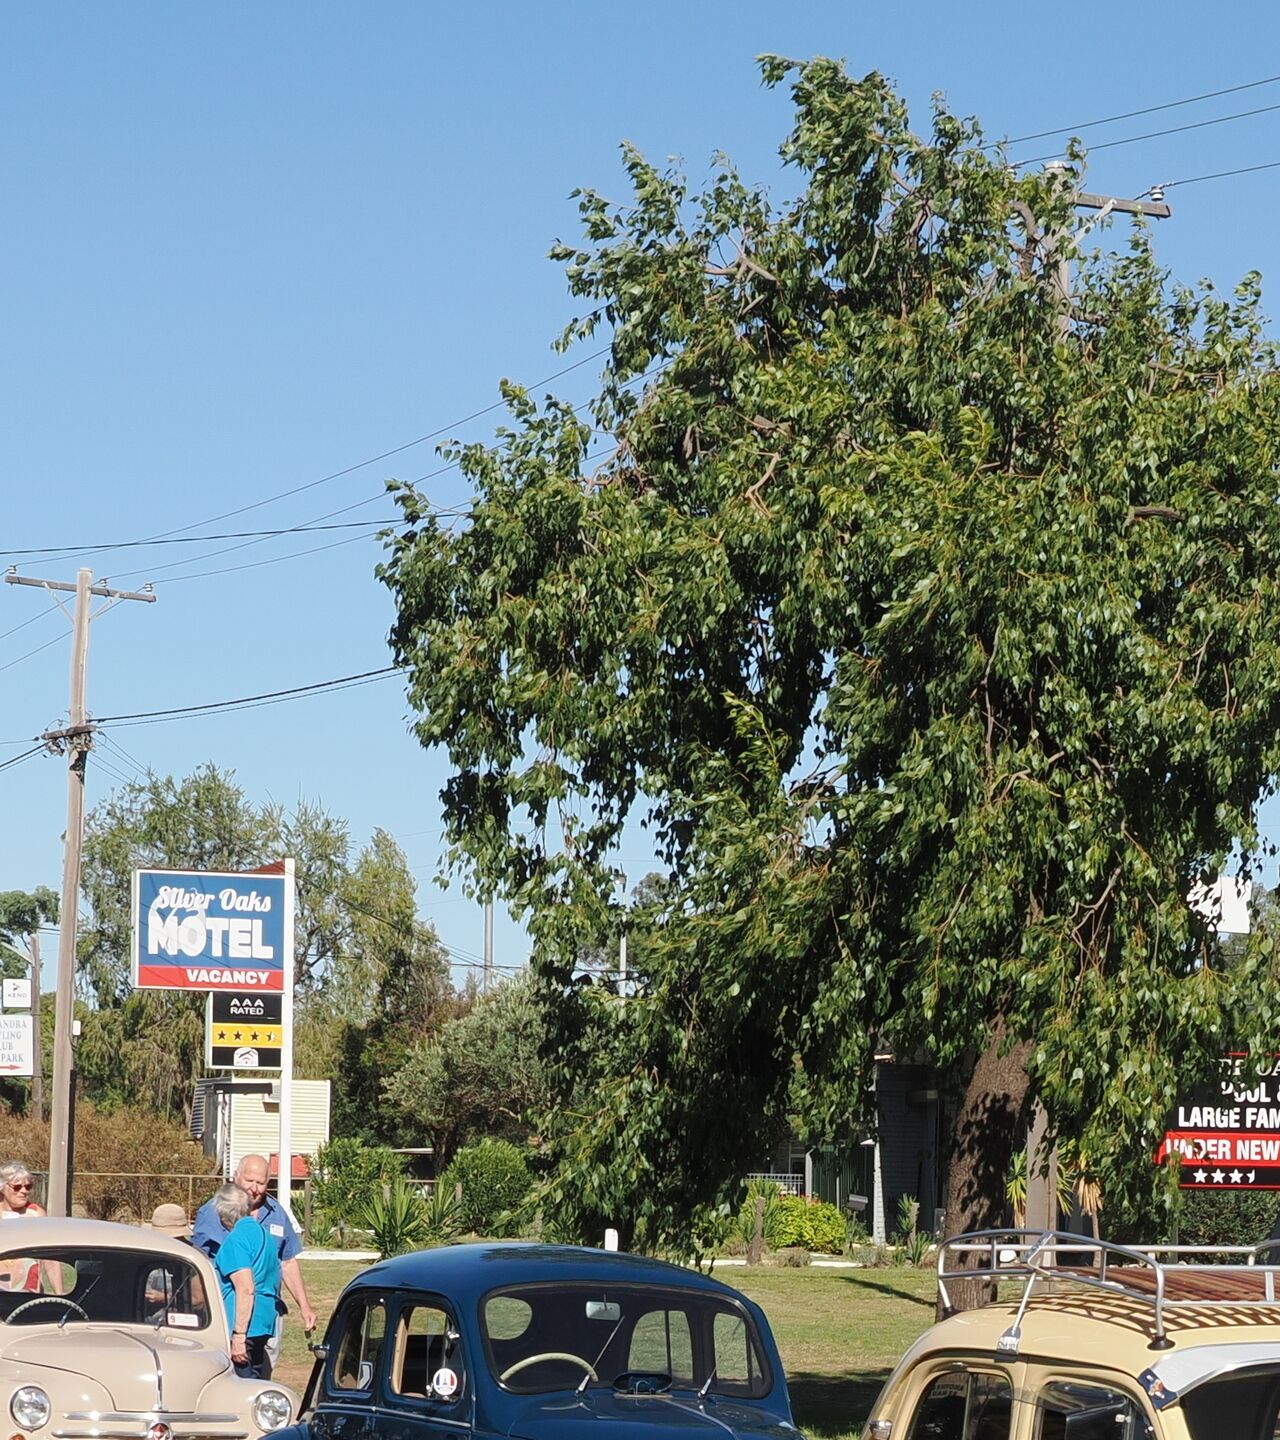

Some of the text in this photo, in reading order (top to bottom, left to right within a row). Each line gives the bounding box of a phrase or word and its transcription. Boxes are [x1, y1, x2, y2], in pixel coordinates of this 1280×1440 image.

[158, 886, 271, 912] Silver Oaks
[148, 914, 273, 959] MOTEL
[186, 968, 270, 985] VACANCY
[230, 1007, 264, 1015] RATED
[1, 1053, 24, 1062] PARK
[1178, 1106, 1240, 1128] LARGE
[1236, 1139, 1280, 1161] NEW
